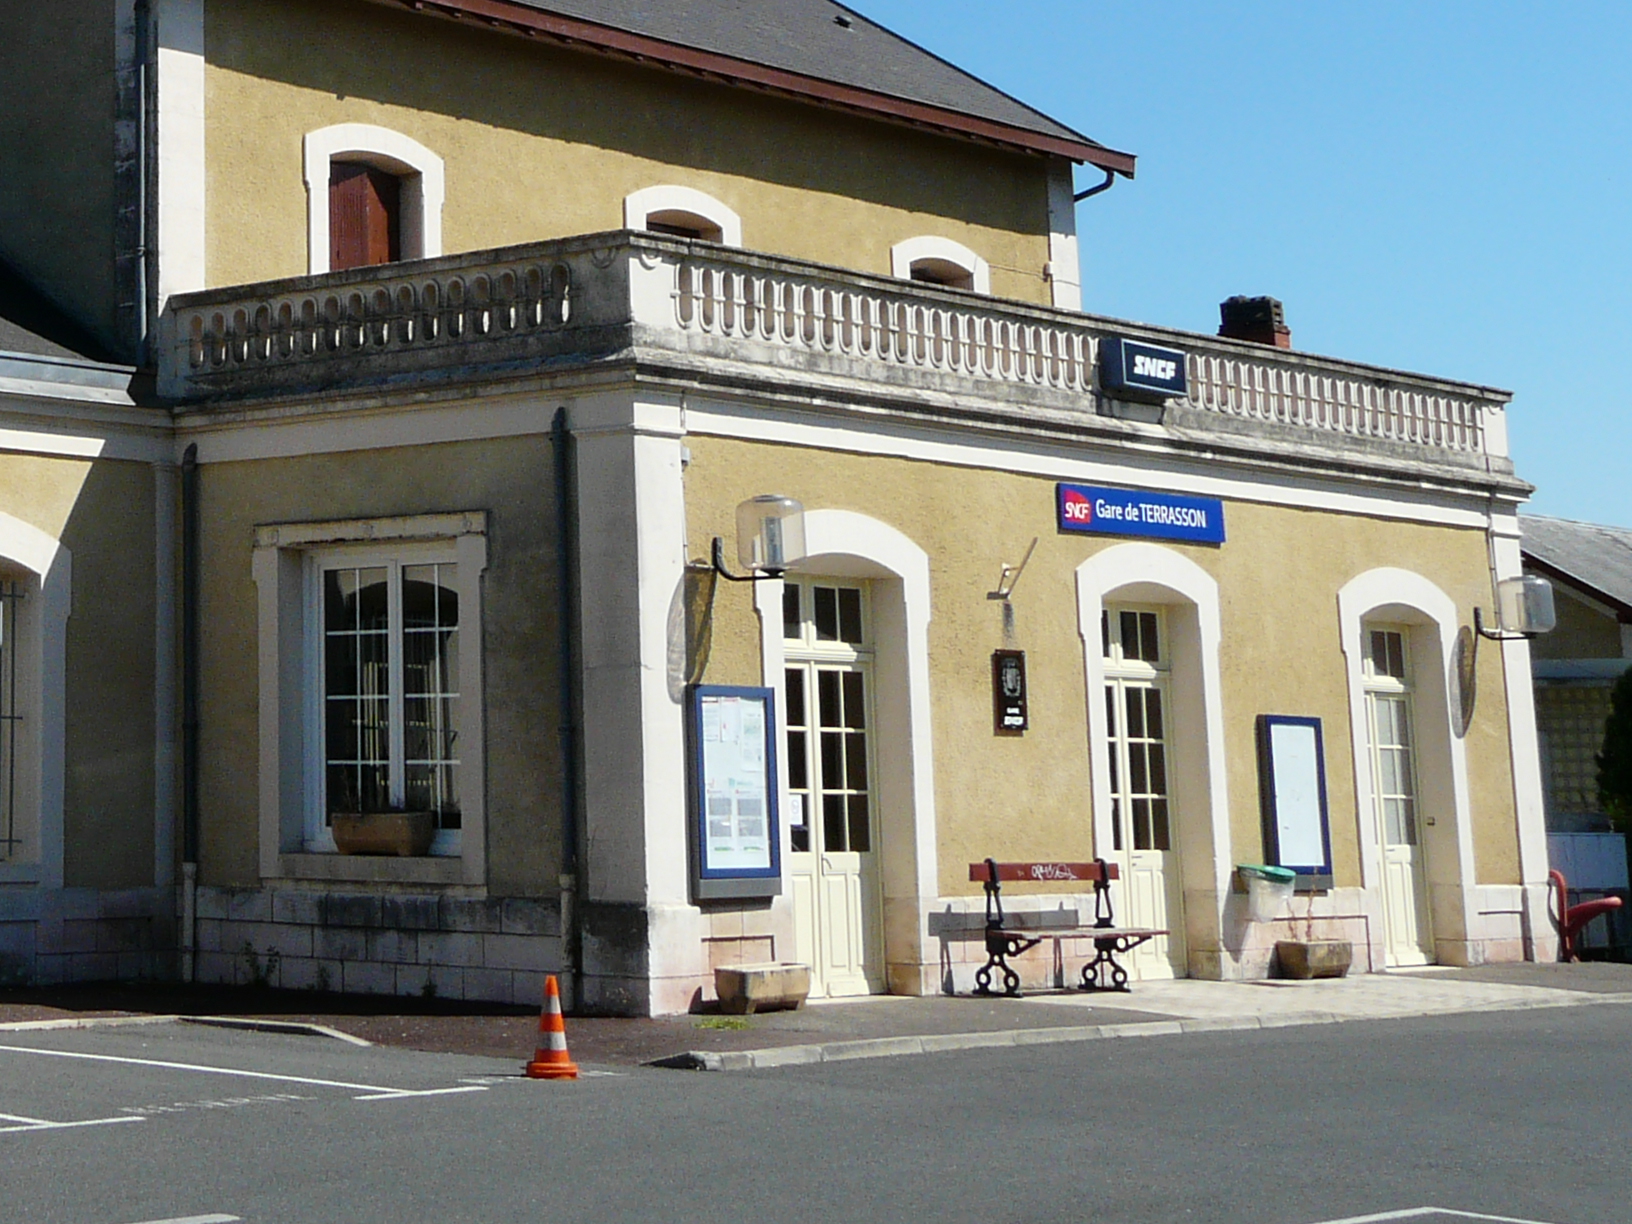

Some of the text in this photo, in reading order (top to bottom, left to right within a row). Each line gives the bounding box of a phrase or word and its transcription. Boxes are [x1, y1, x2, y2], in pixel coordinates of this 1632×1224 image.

[1134, 355, 1176, 380] SNCF
[1065, 502, 1089, 519] SNCF
[1095, 499, 1206, 528] Gare de TERRASSON
